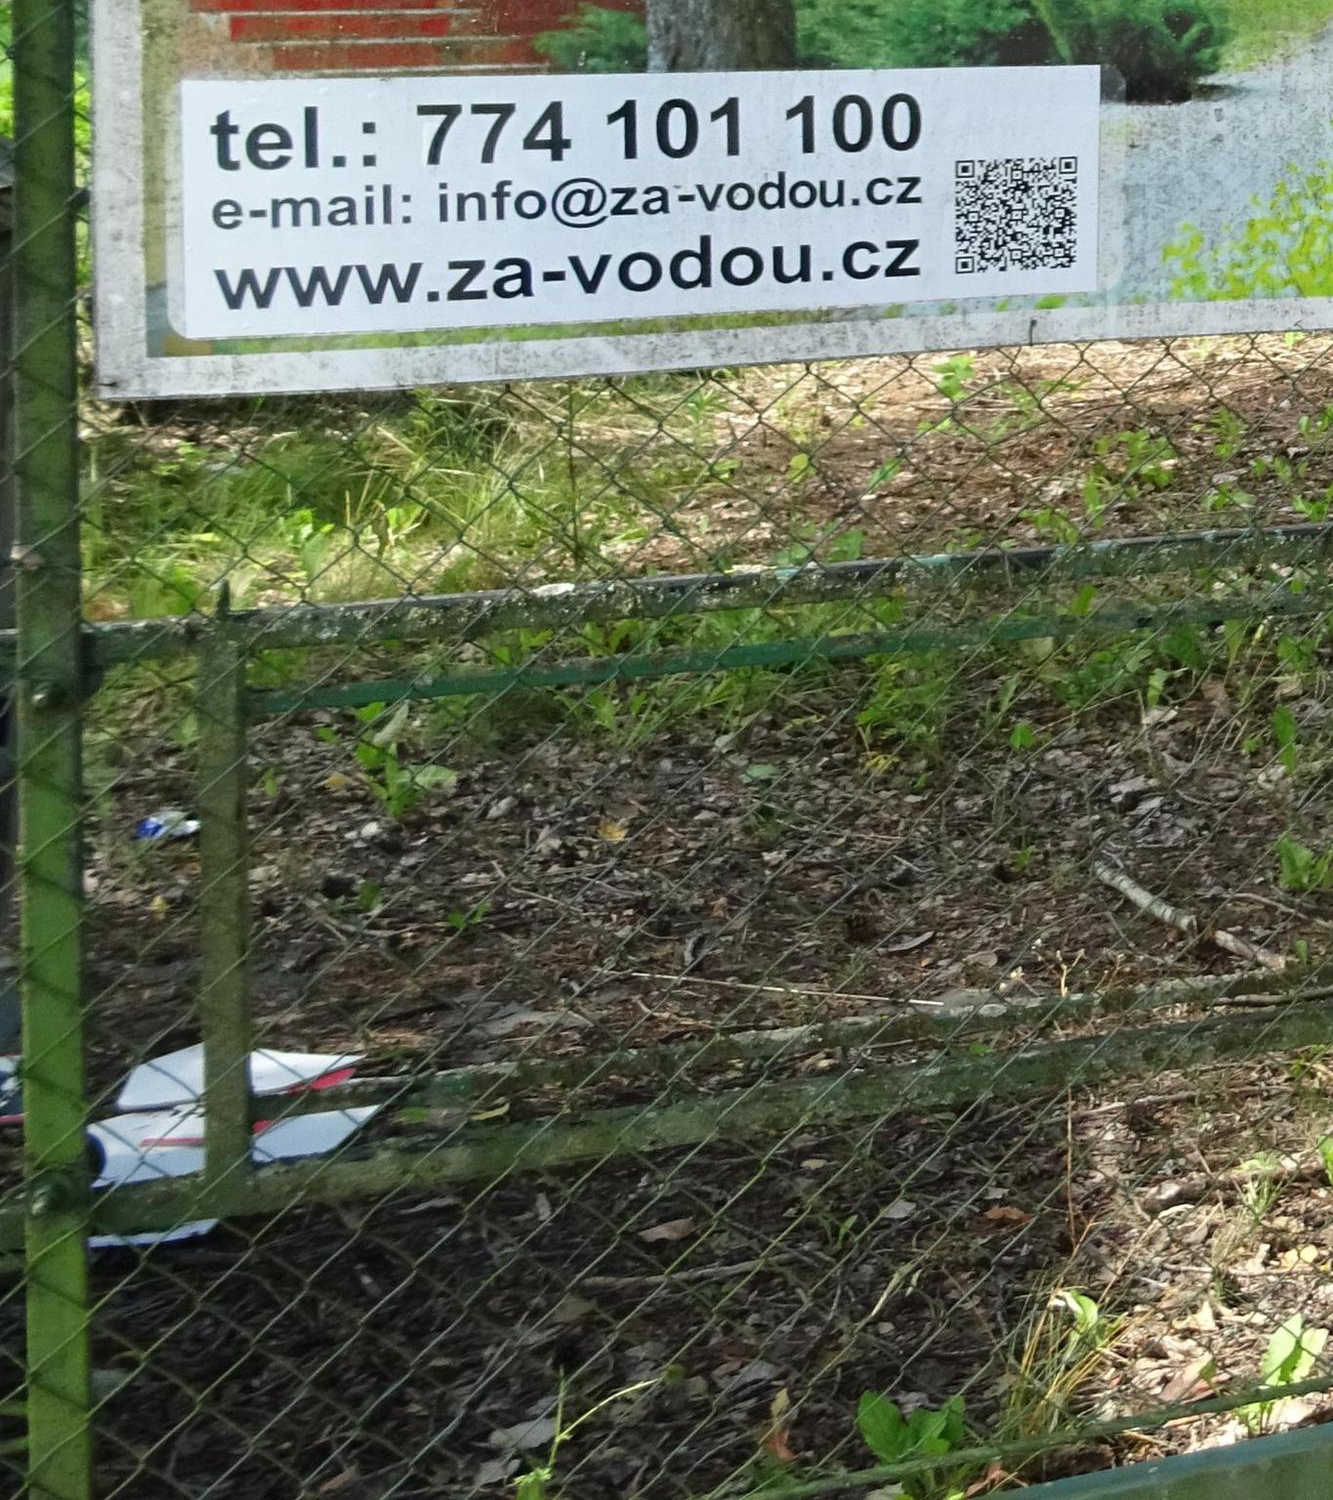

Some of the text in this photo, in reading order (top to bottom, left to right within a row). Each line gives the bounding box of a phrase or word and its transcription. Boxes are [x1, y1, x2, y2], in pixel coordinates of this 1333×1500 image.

[209, 92, 922, 171] tel.: 774 101 100
[211, 171, 923, 230] e-mail: info@za-vodou.cz
[213, 234, 922, 311] www.za-vodou.cz
